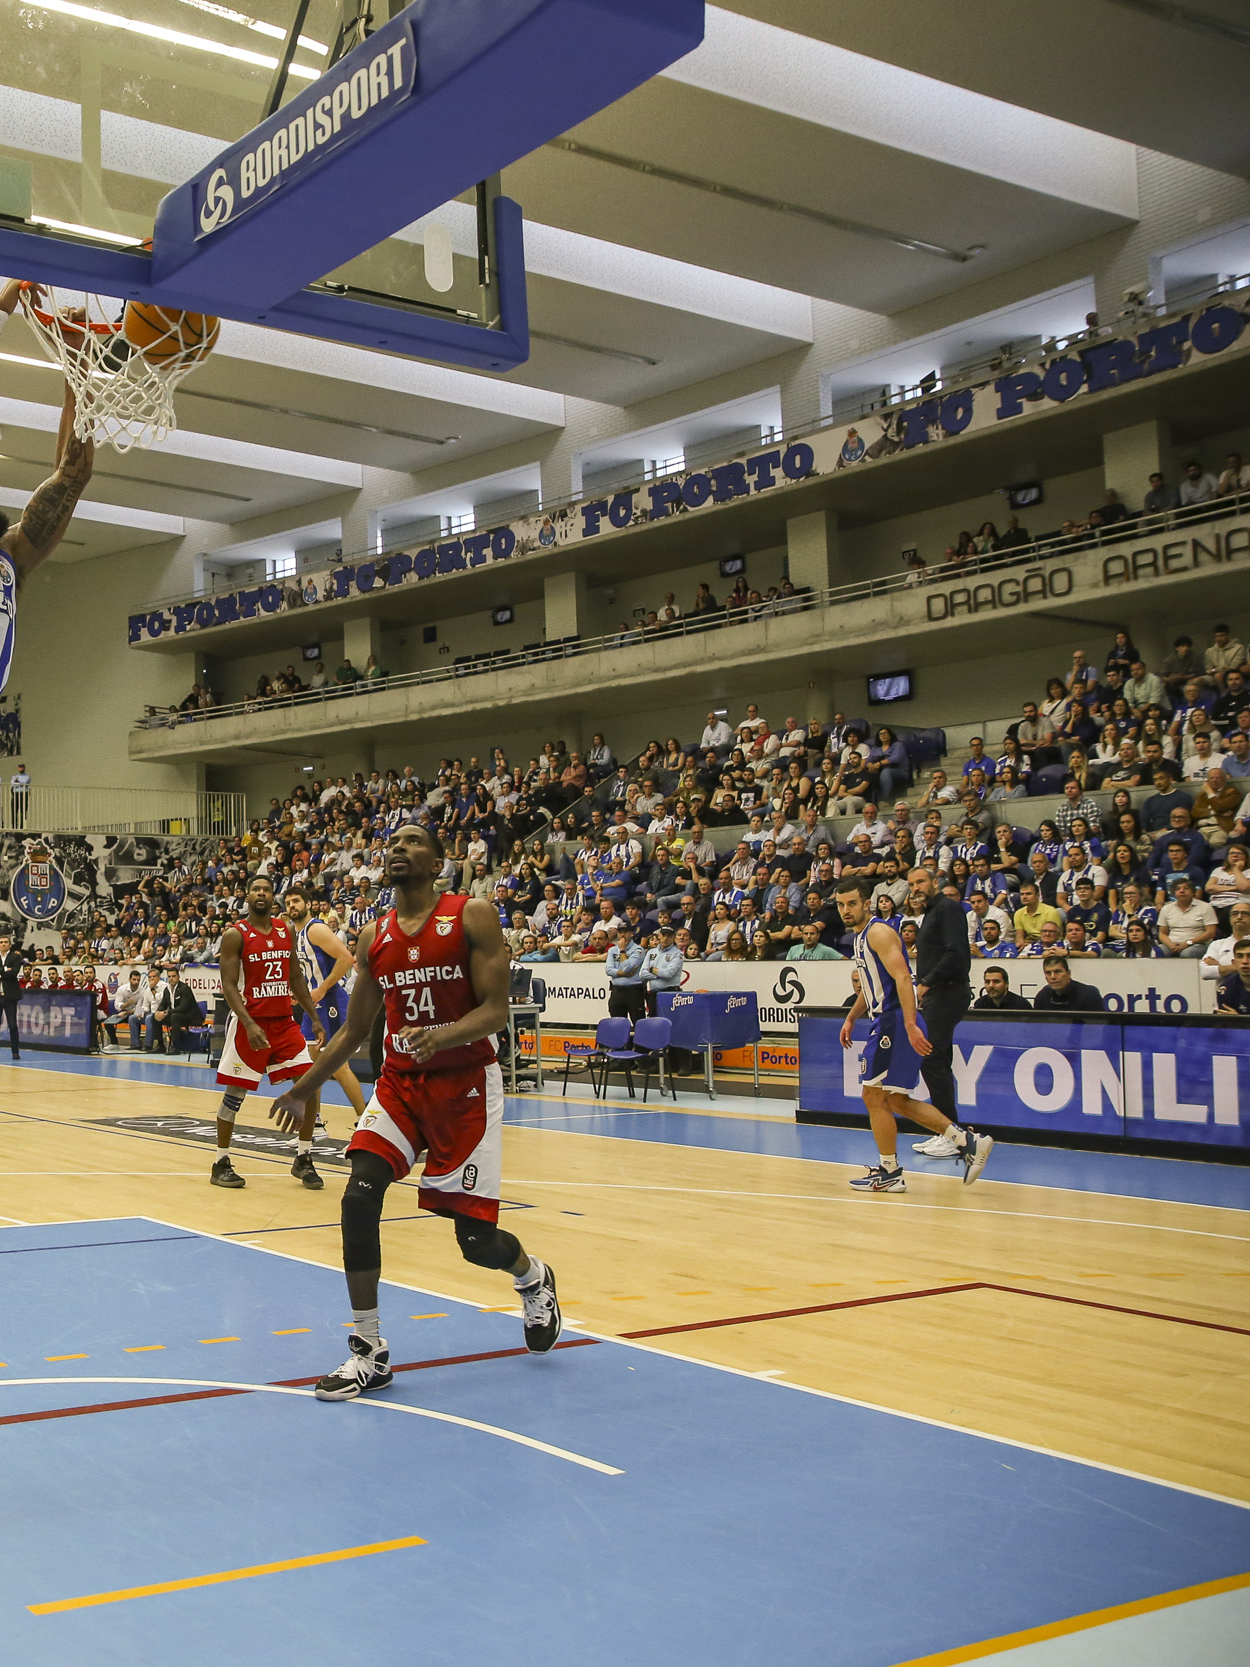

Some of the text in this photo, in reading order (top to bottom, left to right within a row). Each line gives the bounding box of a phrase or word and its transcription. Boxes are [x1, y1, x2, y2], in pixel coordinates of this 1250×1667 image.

[240, 37, 406, 198] BORDISPORT
[900, 306, 1244, 449] FC PORTO
[581, 443, 814, 537] FC PORTO
[333, 527, 516, 597] FC PORTO
[926, 527, 1250, 621] DRAGÃO ARENA
[129, 585, 281, 643] FC PORTO
[249, 954, 260, 962] SL
[261, 950, 291, 960] BENFIC
[264, 961, 283, 980] 23
[185, 979, 223, 989] FIDELIDA
[252, 985, 289, 998] RAMIRE
[378, 965, 463, 989] SL BENFICA
[401, 987, 435, 1021] 34
[1103, 987, 1188, 1013] orto
[761, 1051, 797, 1065] Porto
[843, 1041, 994, 1106] BY
